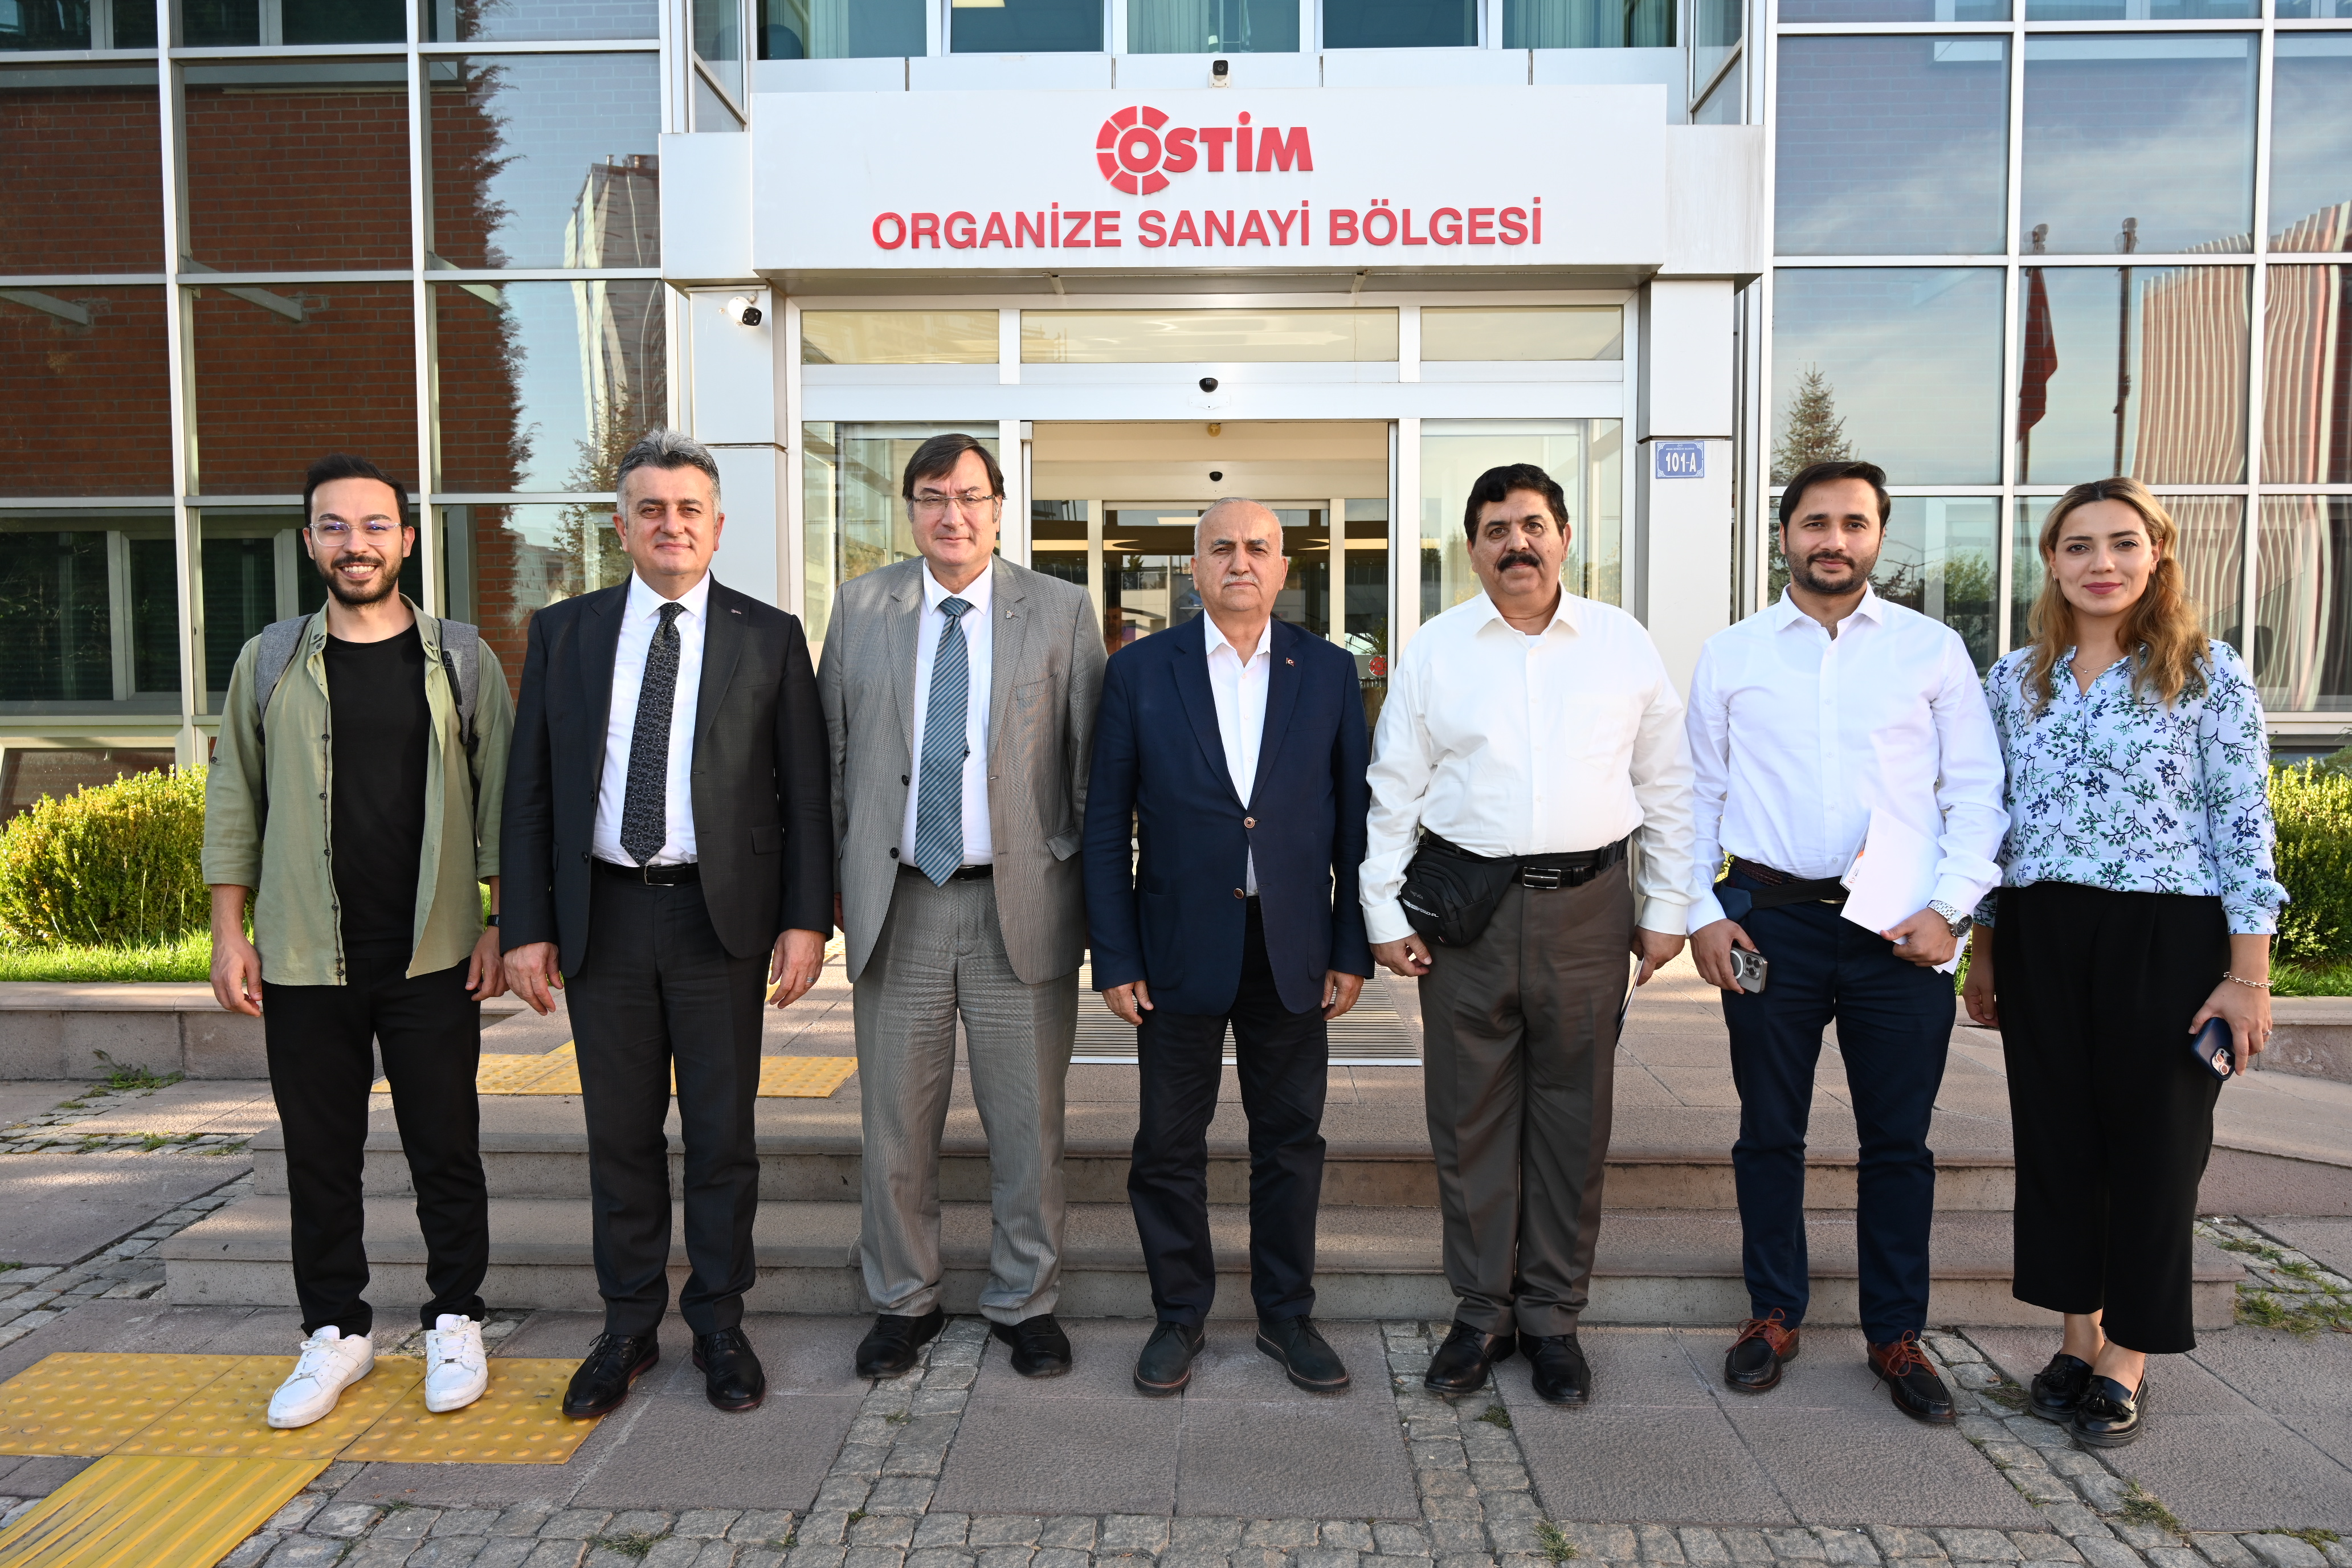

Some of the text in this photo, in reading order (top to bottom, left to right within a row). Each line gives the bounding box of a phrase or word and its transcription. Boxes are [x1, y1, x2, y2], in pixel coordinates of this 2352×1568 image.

[1118, 111, 1314, 173] OSTİM
[872, 196, 1541, 250] ORGANİZE SANAYİ BÖLGESİ
[1665, 452, 1697, 472] 101-A
